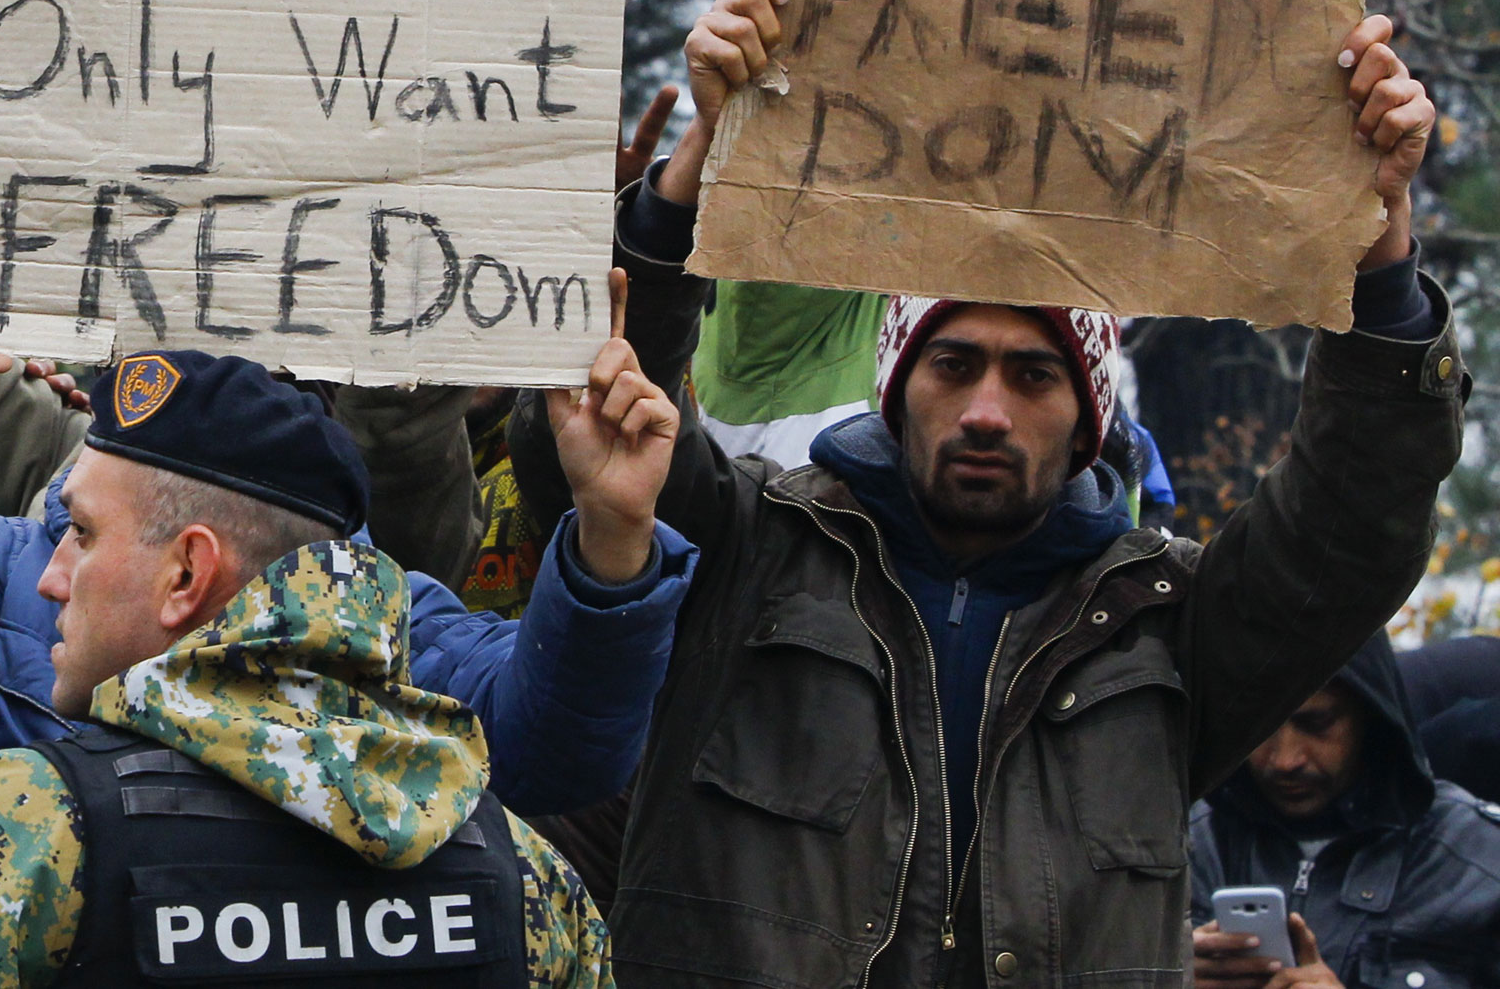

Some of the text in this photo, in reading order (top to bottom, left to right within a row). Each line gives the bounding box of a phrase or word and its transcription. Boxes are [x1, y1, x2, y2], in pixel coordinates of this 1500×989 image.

[289, 11, 577, 122] Want
[787, 87, 1188, 238] DOM
[132, 379, 156, 396] PM
[155, 894, 476, 964] POLICE
